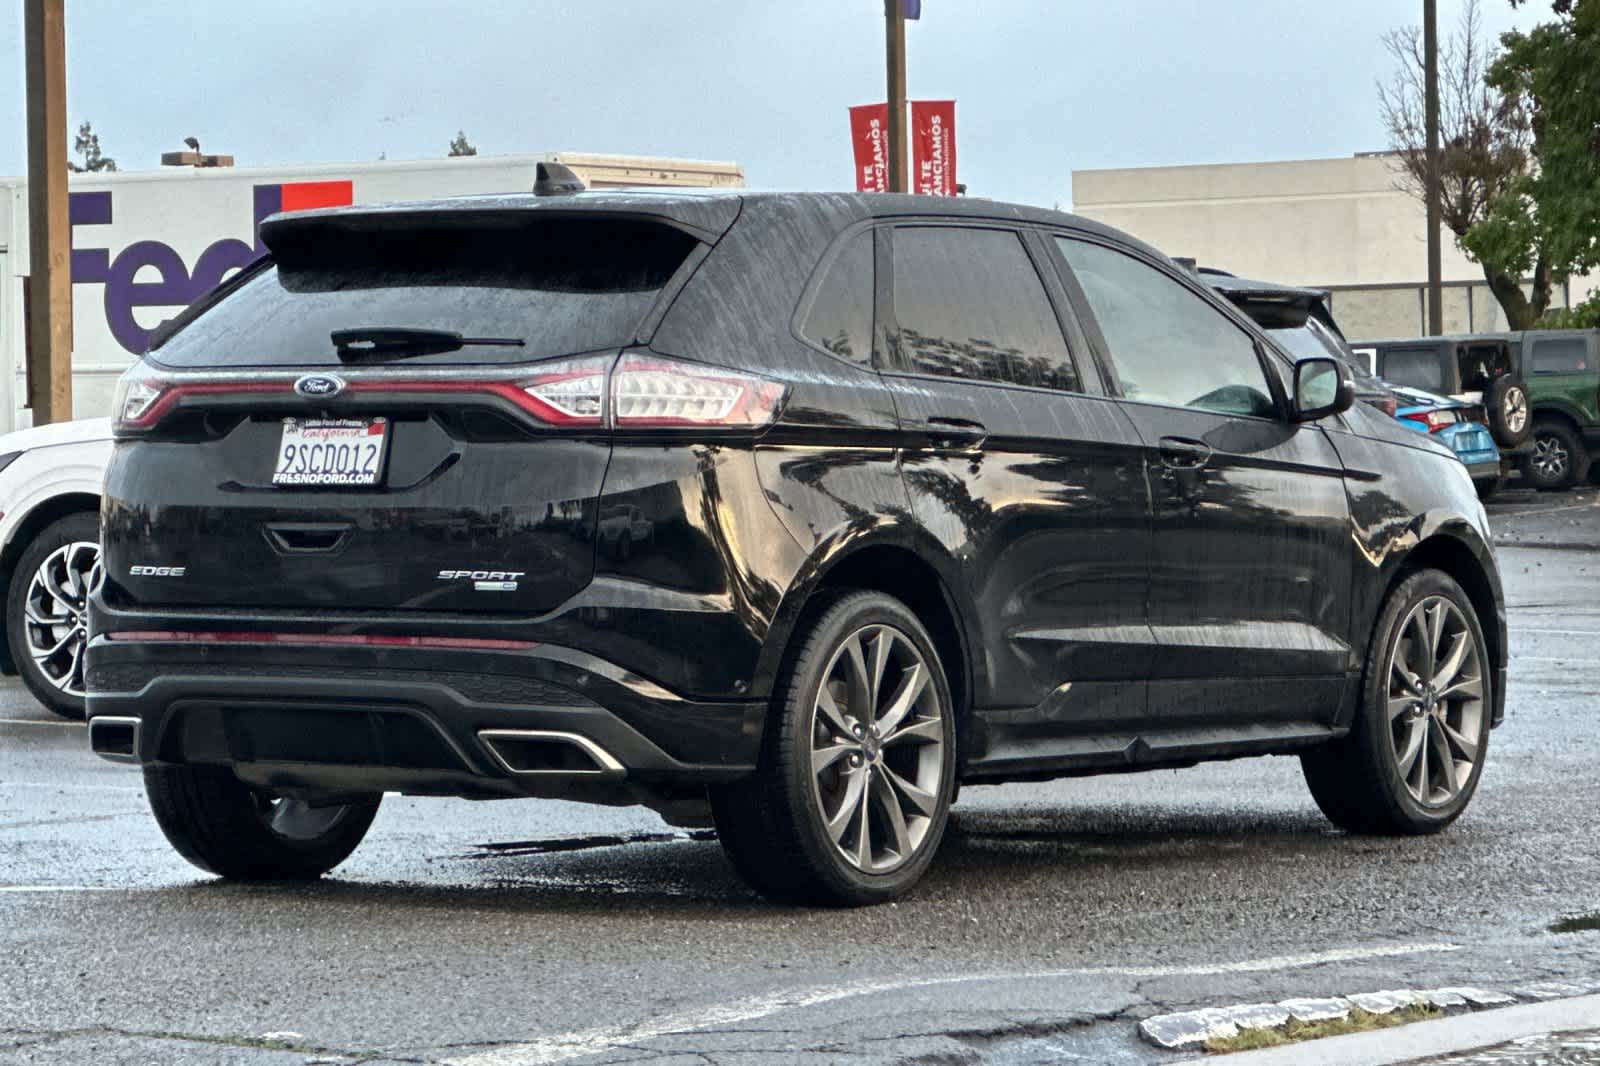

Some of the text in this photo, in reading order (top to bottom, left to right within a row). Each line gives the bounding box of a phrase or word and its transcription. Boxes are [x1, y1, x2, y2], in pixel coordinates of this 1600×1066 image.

[864, 164, 874, 184] TE
[921, 160, 932, 179] TE
[281, 443, 377, 475] 9SCD012
[272, 473, 375, 484] FRESNOFORD.COM
[129, 565, 186, 577] EDGE
[437, 570, 525, 580] SPORT
